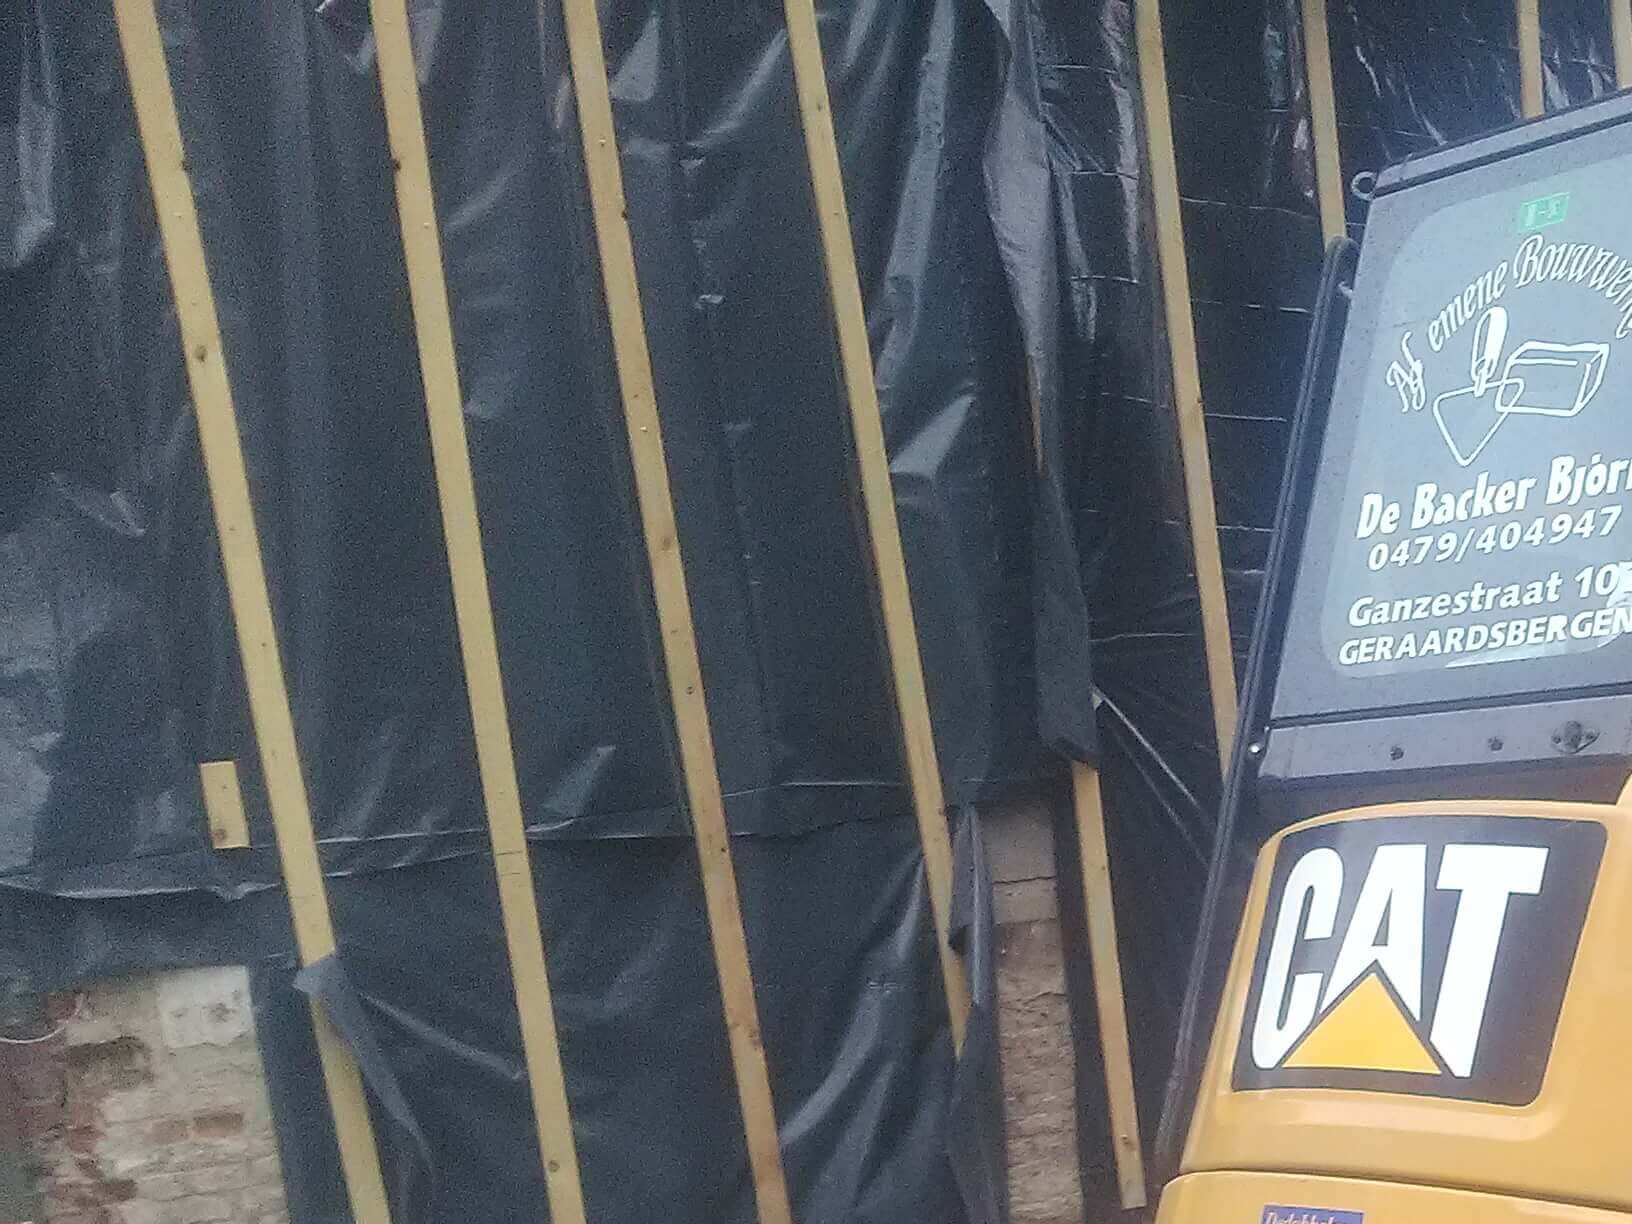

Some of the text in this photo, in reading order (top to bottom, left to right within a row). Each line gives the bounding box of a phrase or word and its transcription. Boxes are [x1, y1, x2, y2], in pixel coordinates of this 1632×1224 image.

[1356, 493, 1400, 539] De
[1411, 471, 1537, 529] Backer
[1367, 504, 1622, 572] 0479/404947
[1349, 571, 1563, 627] Ganzestraat
[1251, 844, 1550, 1079] CAT
